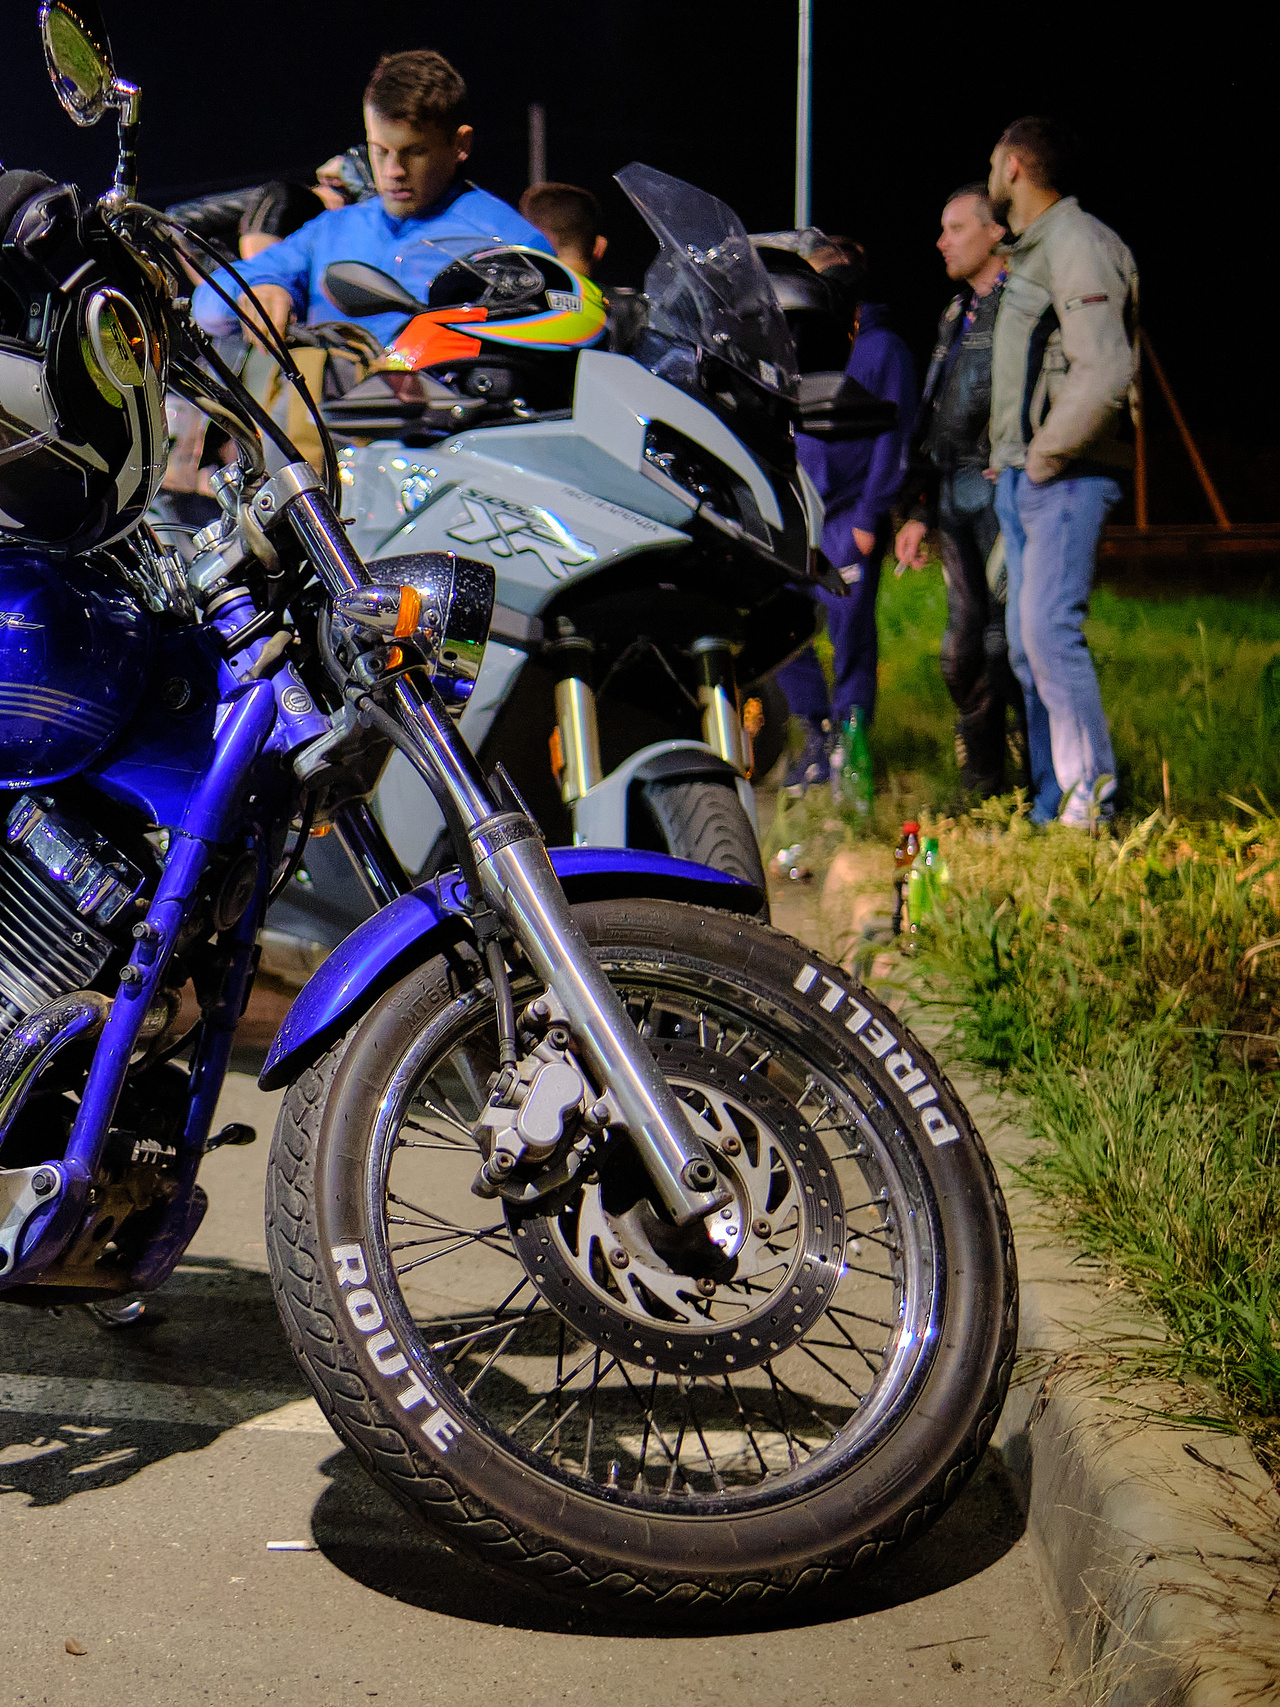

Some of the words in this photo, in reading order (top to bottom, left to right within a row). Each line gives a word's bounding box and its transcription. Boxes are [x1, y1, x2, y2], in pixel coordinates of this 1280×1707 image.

[446, 495, 597, 579] XR
[793, 963, 960, 1147] PIRELLI
[331, 1243, 463, 1453] ROUTE
